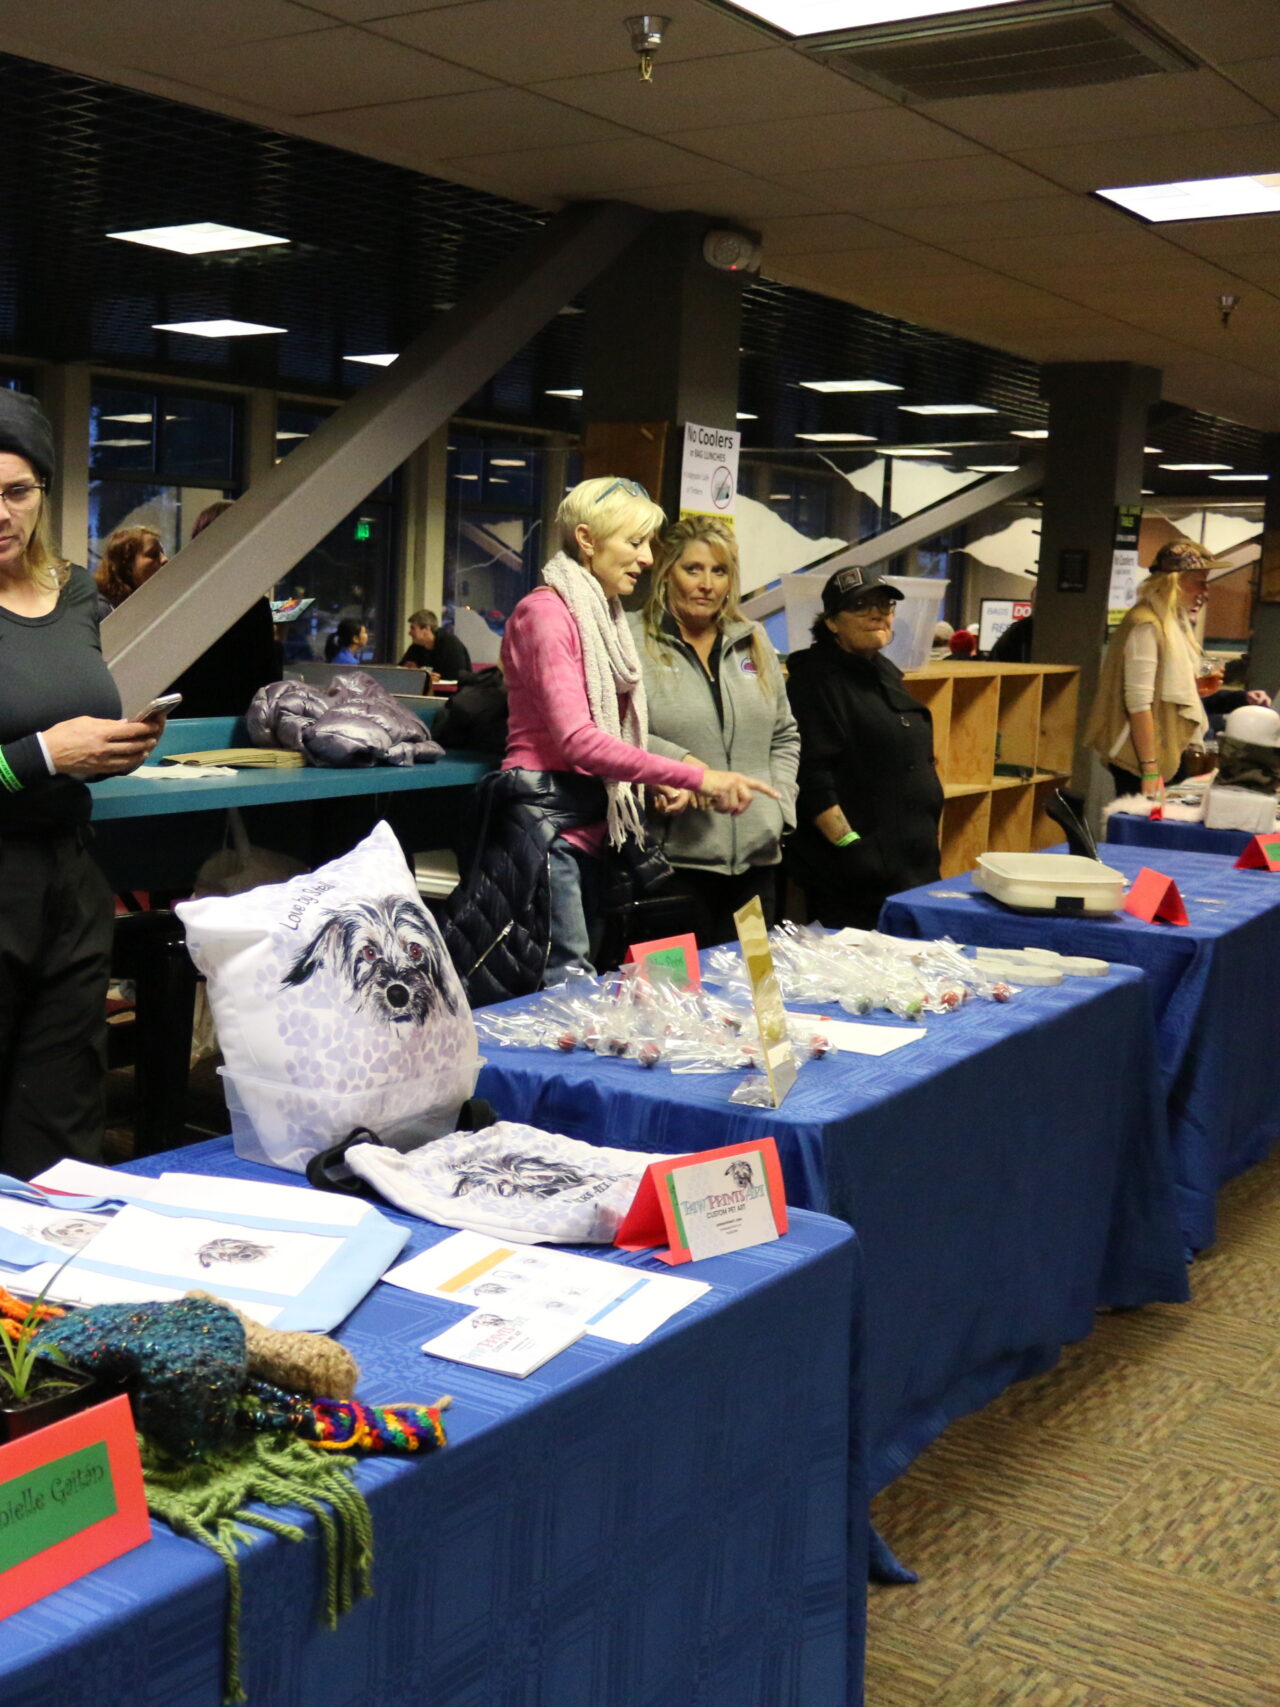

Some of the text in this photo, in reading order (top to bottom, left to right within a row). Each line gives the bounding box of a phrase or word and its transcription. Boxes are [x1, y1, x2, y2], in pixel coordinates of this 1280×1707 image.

[688, 425, 733, 449] No Coolers
[279, 904, 306, 931] Love
